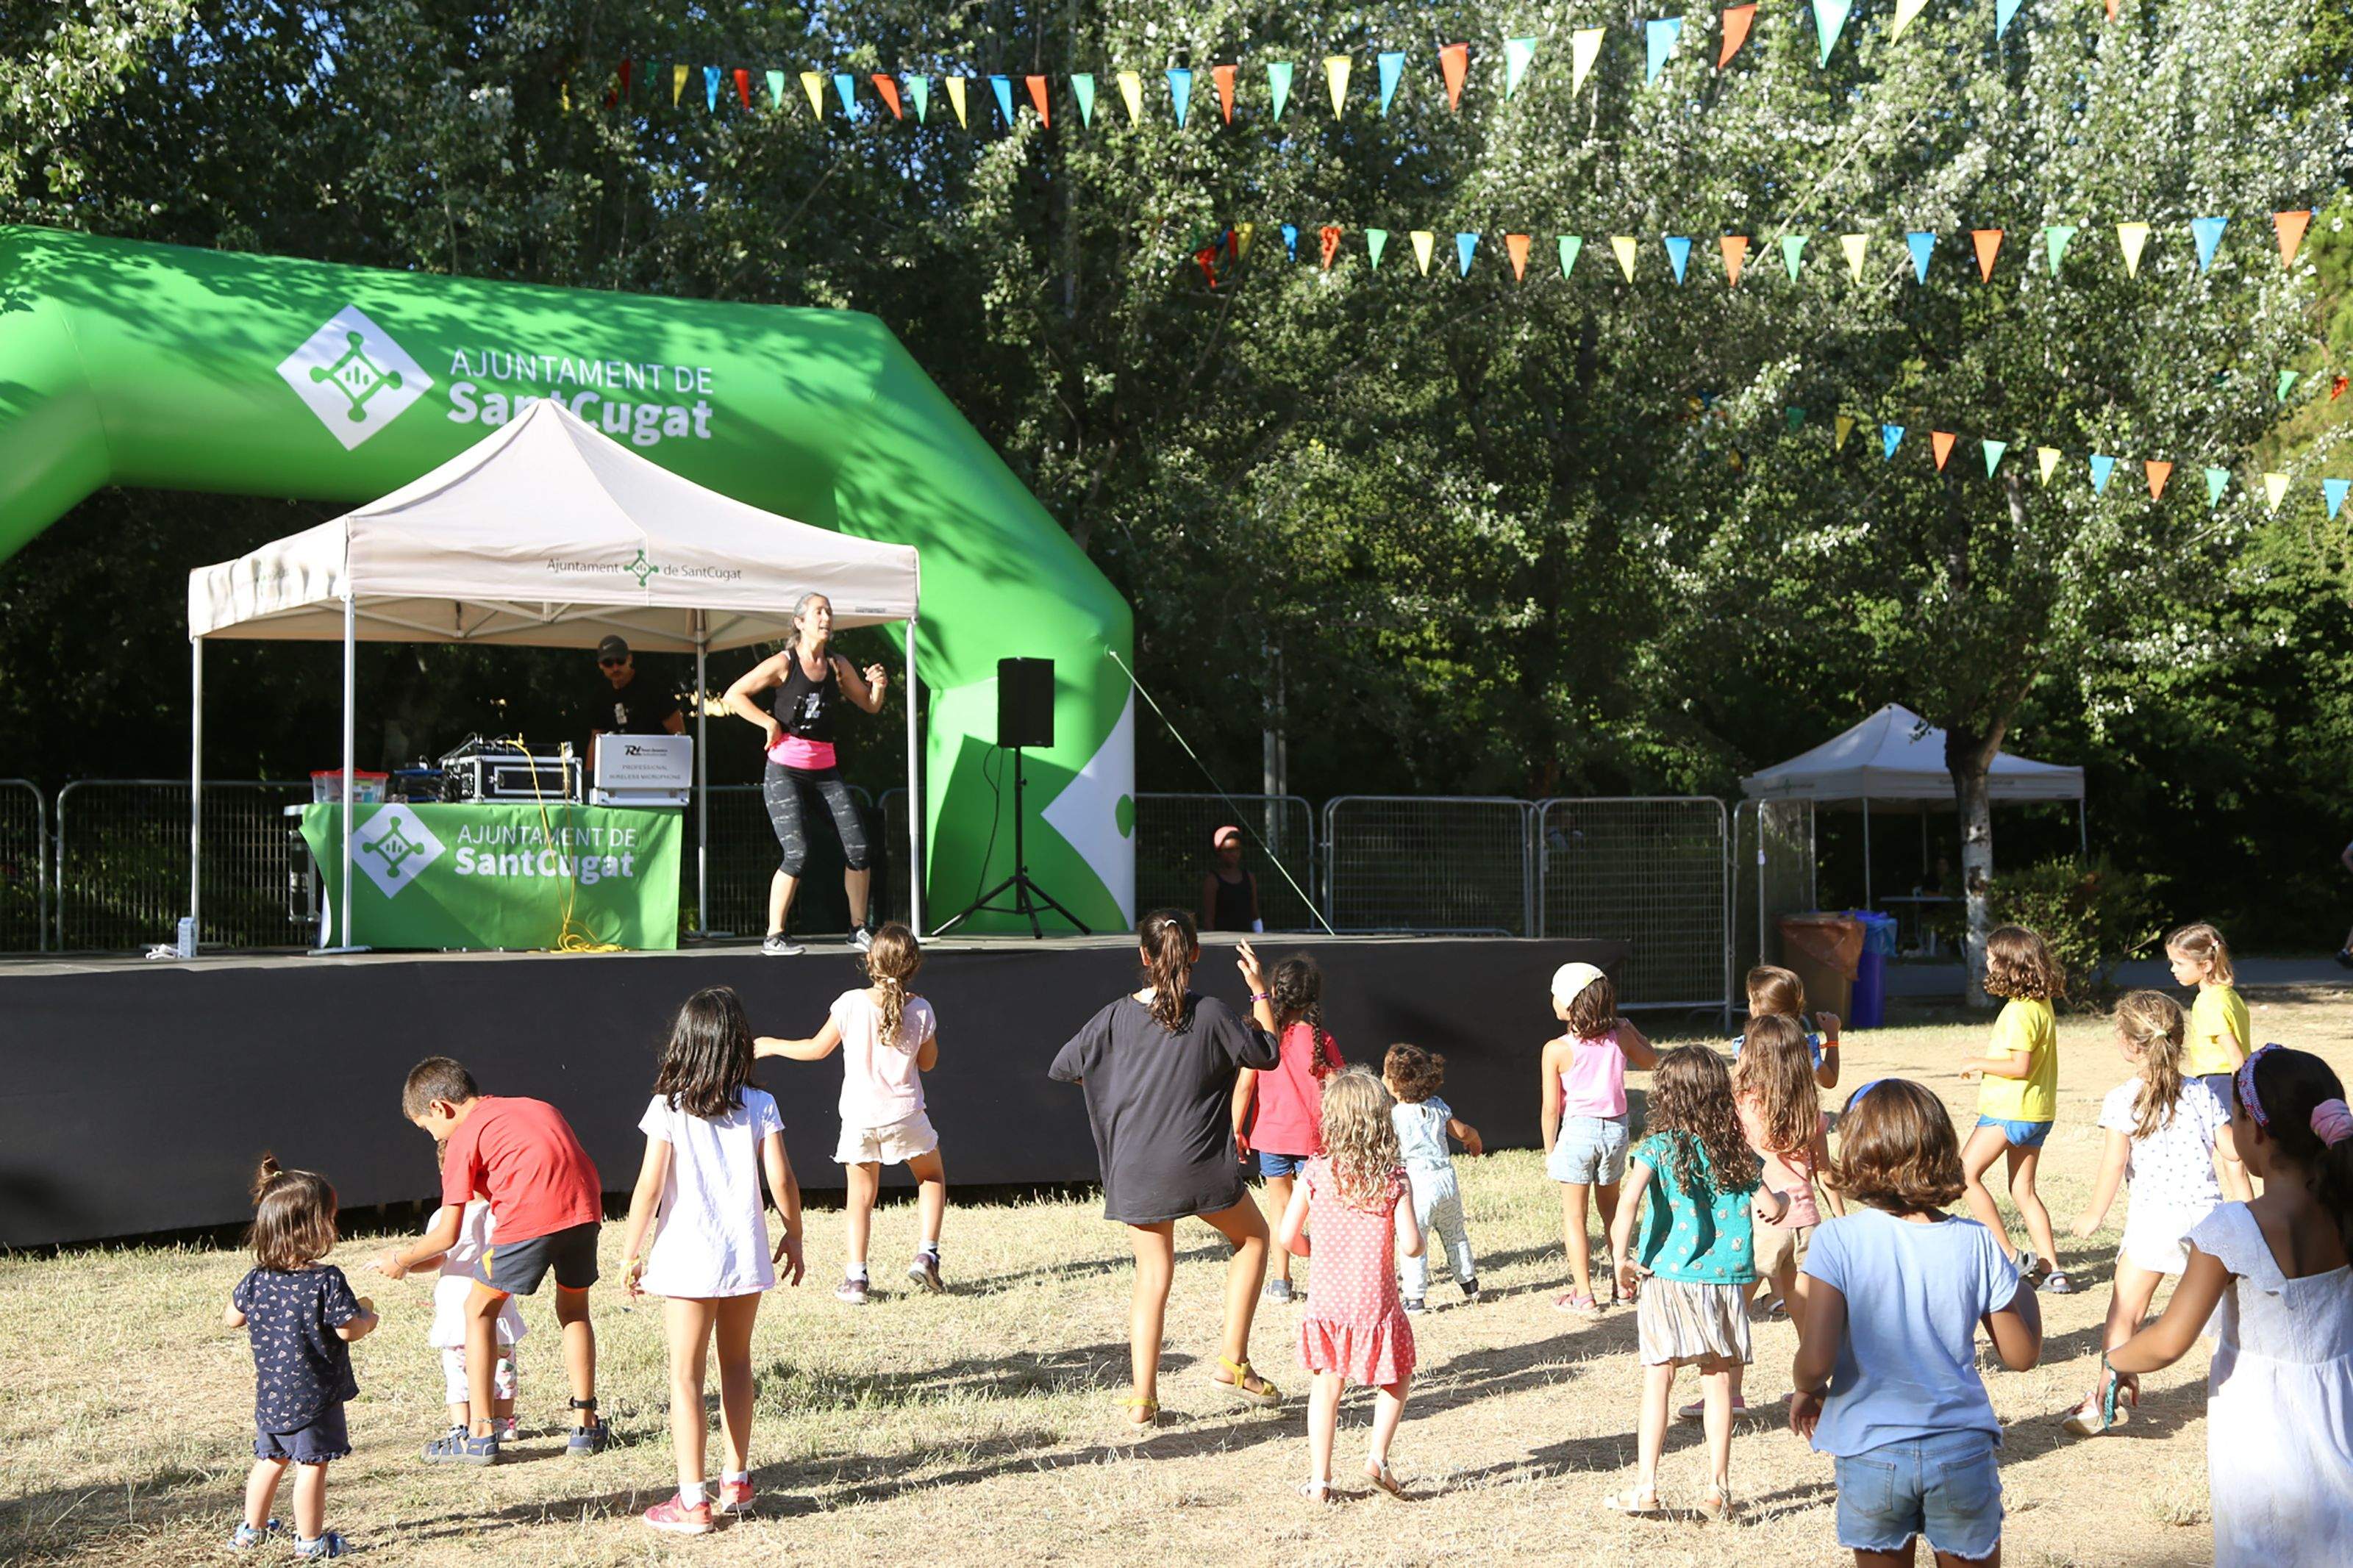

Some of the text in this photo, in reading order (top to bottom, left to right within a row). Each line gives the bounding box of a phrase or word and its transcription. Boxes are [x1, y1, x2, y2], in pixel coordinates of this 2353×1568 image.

[450, 348, 714, 394] AJUNTAMENT DE
[547, 558, 742, 581] Ajuntament de SantCugat
[457, 824, 637, 848] AJUNTAMENT DE
[454, 846, 634, 885] SantCugat
